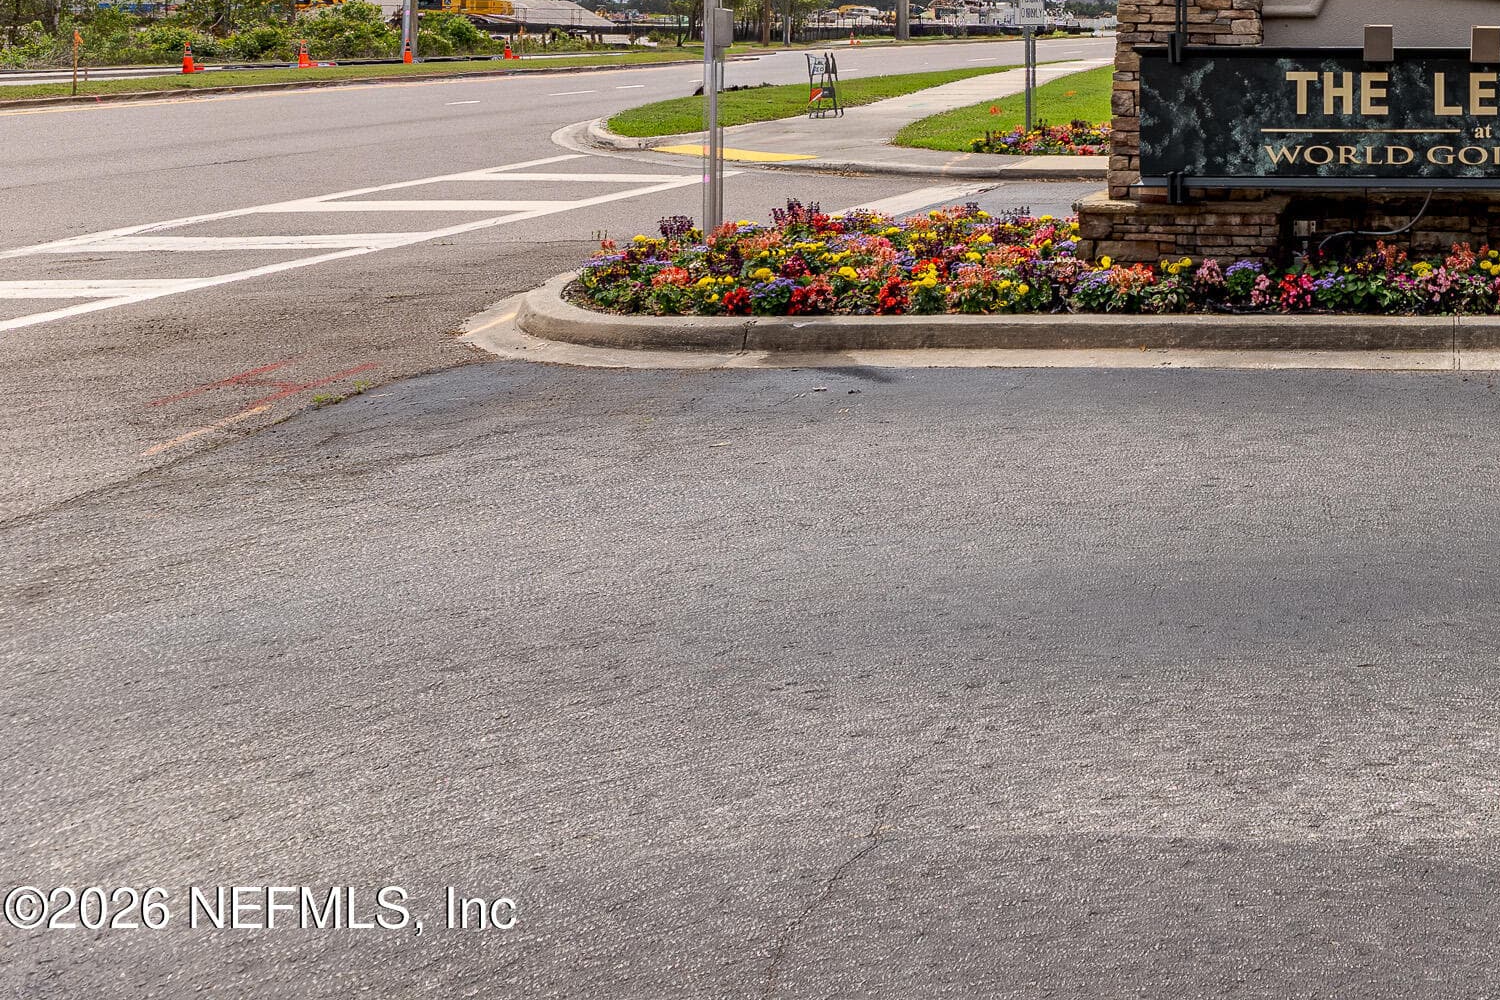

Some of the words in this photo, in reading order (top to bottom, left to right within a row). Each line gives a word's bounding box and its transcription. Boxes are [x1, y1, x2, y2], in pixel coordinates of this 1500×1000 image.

[1285, 71, 1389, 115] THE
[1474, 123, 1493, 139] at
[1264, 145, 1415, 165] WORLD
